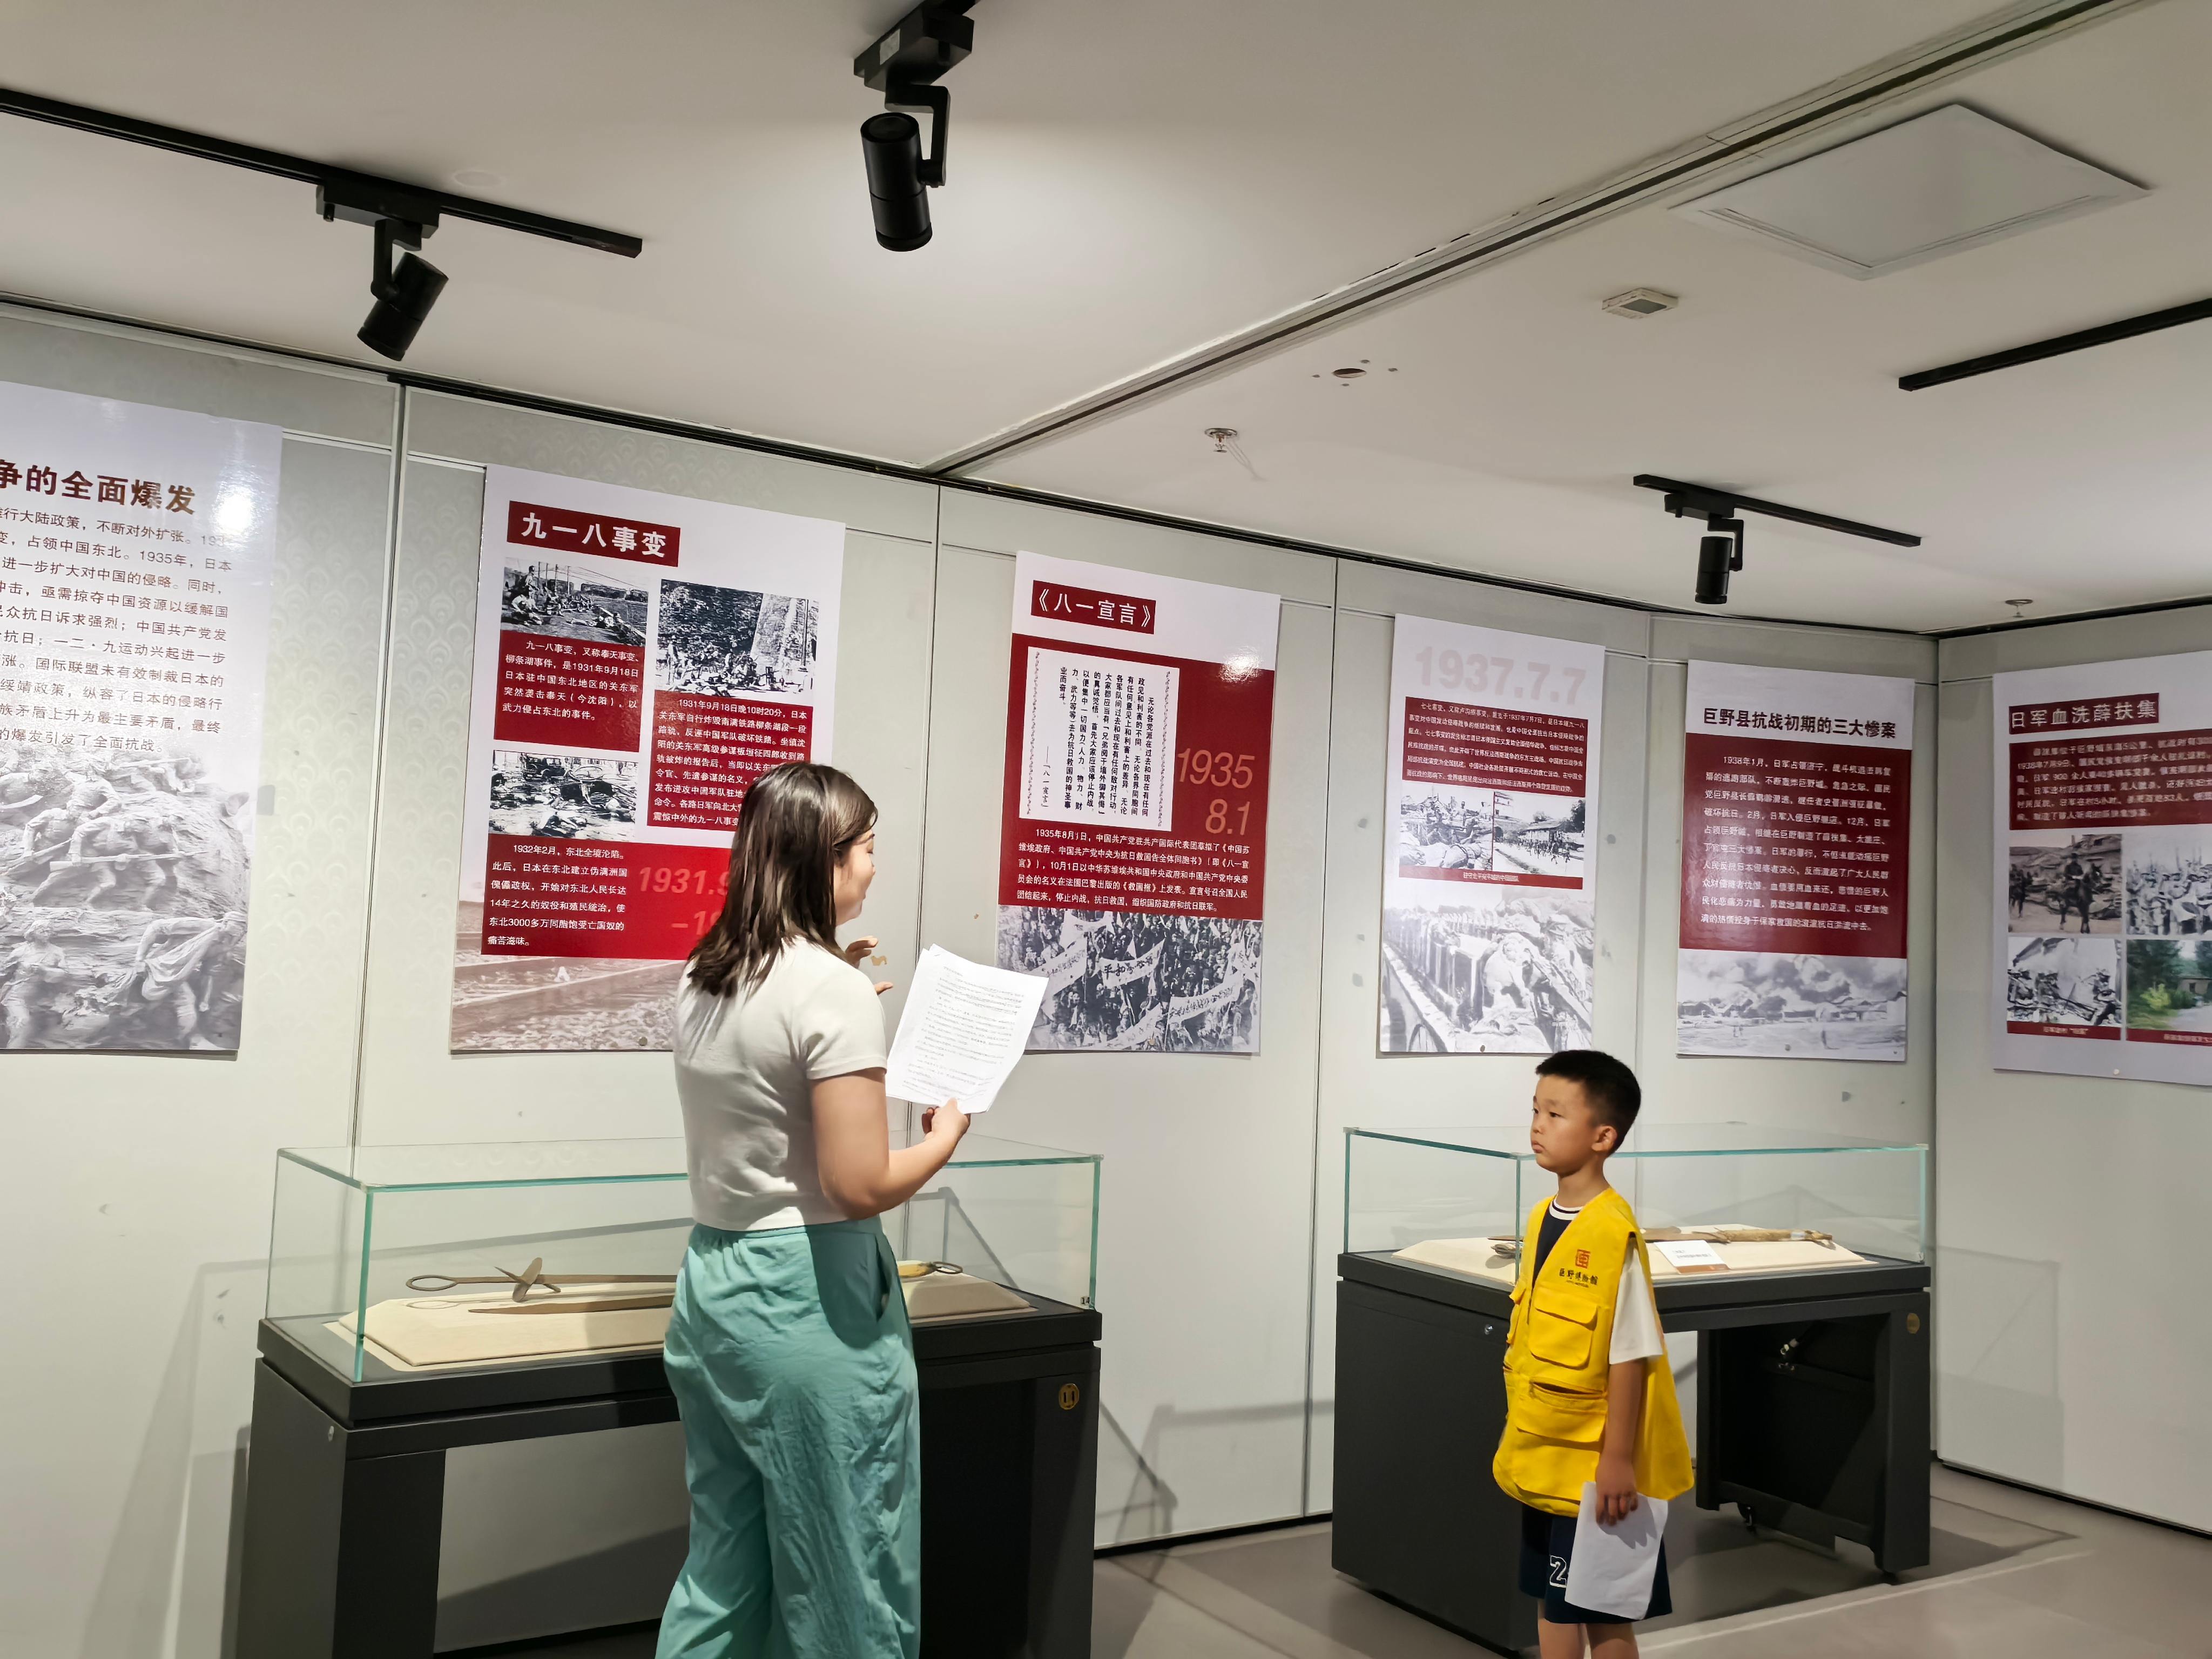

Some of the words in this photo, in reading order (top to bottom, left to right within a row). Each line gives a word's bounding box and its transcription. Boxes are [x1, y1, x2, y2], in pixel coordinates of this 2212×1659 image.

[521, 512, 667, 559] 九一八事变
[0, 605, 227, 642] 众抗日诉求强烈；中国共产党发
[1039, 588, 1151, 628] 《八一宣言》
[0, 630, 226, 664] 抗日；一二·九运动兴起进一步
[505, 670, 638, 693] 日本驻中国东北地区的关东军
[1415, 646, 1586, 705] 1937.7.7
[502, 703, 595, 721] 武力侵占东北的事件。
[1703, 708, 1896, 739] 巨野县抗战初期的三大惨案
[2012, 699, 2156, 729] 日军血洗薛扶集
[1178, 747, 1256, 789] 1935
[1205, 798, 1250, 835] 8.1
